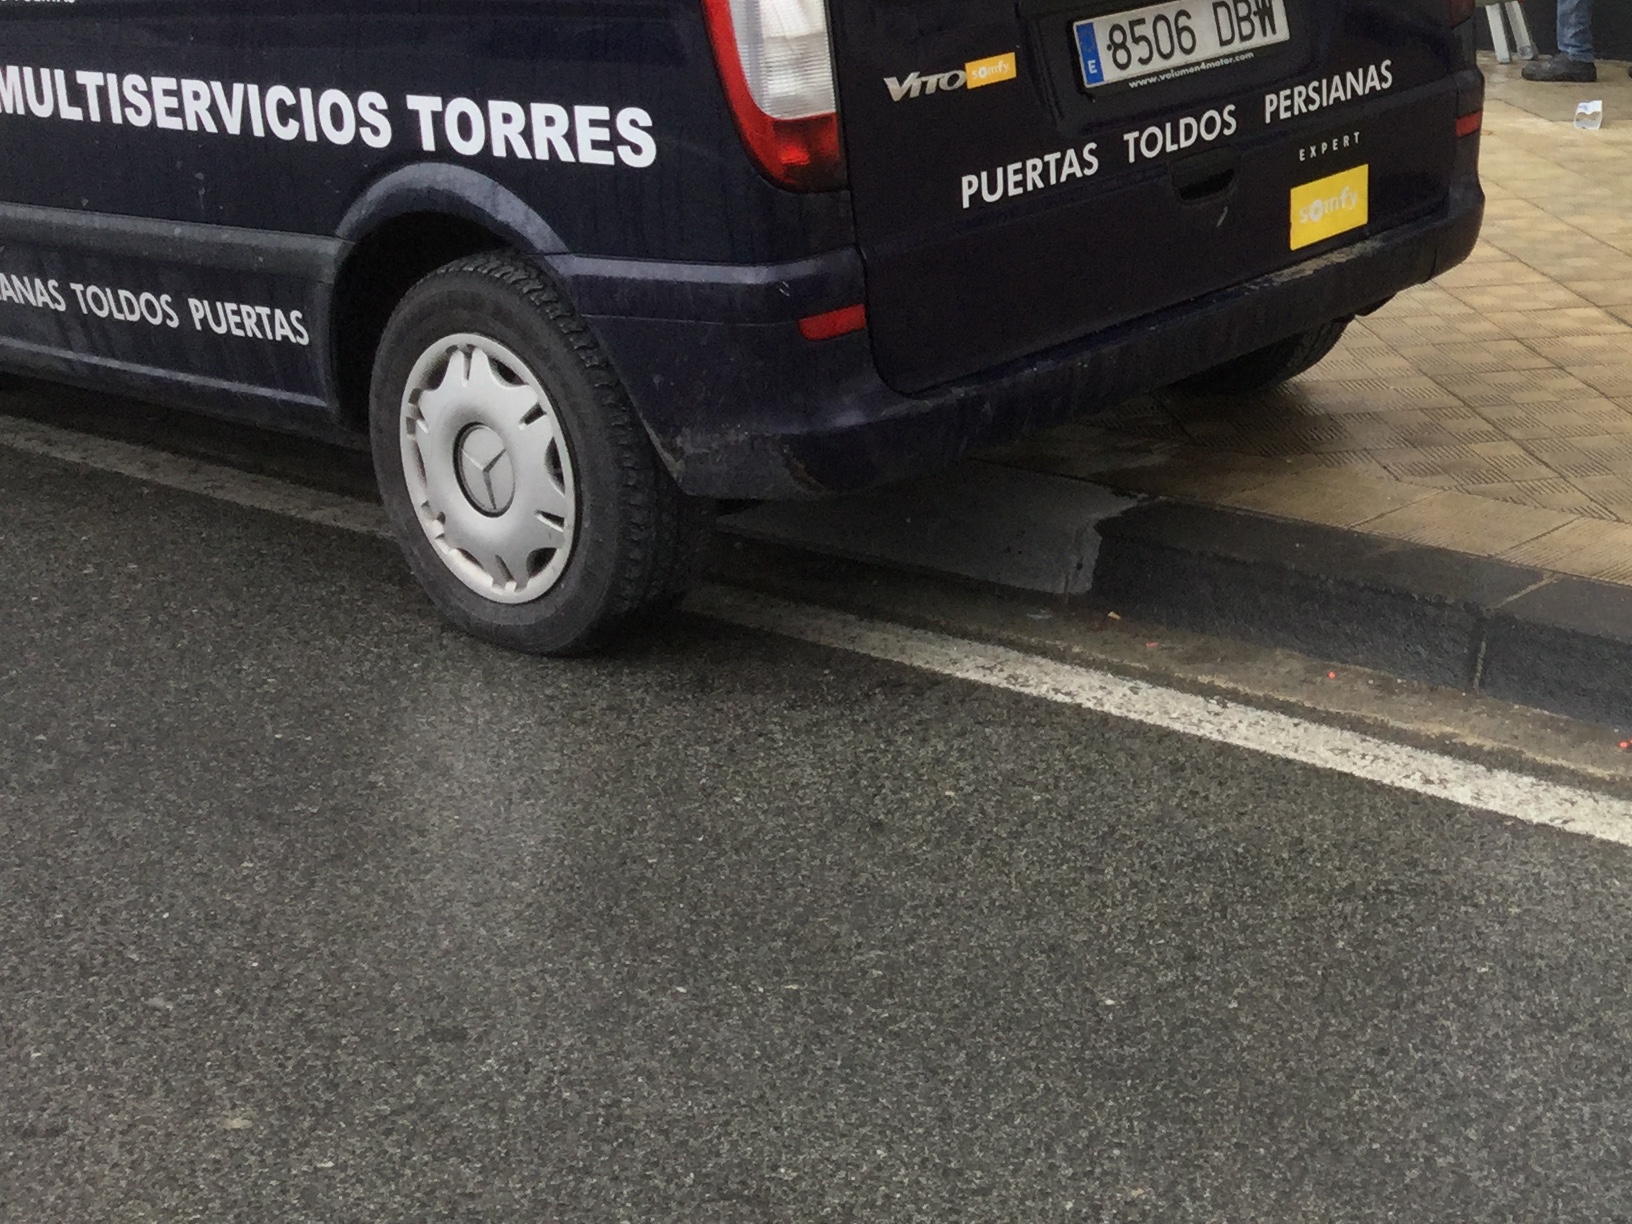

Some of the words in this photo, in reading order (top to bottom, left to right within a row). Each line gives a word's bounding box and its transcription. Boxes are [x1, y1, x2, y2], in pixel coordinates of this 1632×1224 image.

[1107, 9, 1197, 71] 8506
[971, 60, 1010, 80] somfy
[1087, 60, 1097, 74] E
[1128, 51, 1254, 88] www.volumen4motor.com
[0, 64, 392, 149] MULTISERVICIOS
[406, 95, 657, 168] TORRES
[961, 142, 1099, 209] PUERTAS
[1123, 104, 1237, 164] TOLDOS
[1264, 59, 1393, 124] PERSIANAS
[1299, 131, 1360, 162] EXPERT
[1299, 185, 1358, 224] somfy
[0, 272, 66, 312] ANAS
[70, 282, 180, 328] TOLDOS
[187, 298, 310, 346] PUERTAS
